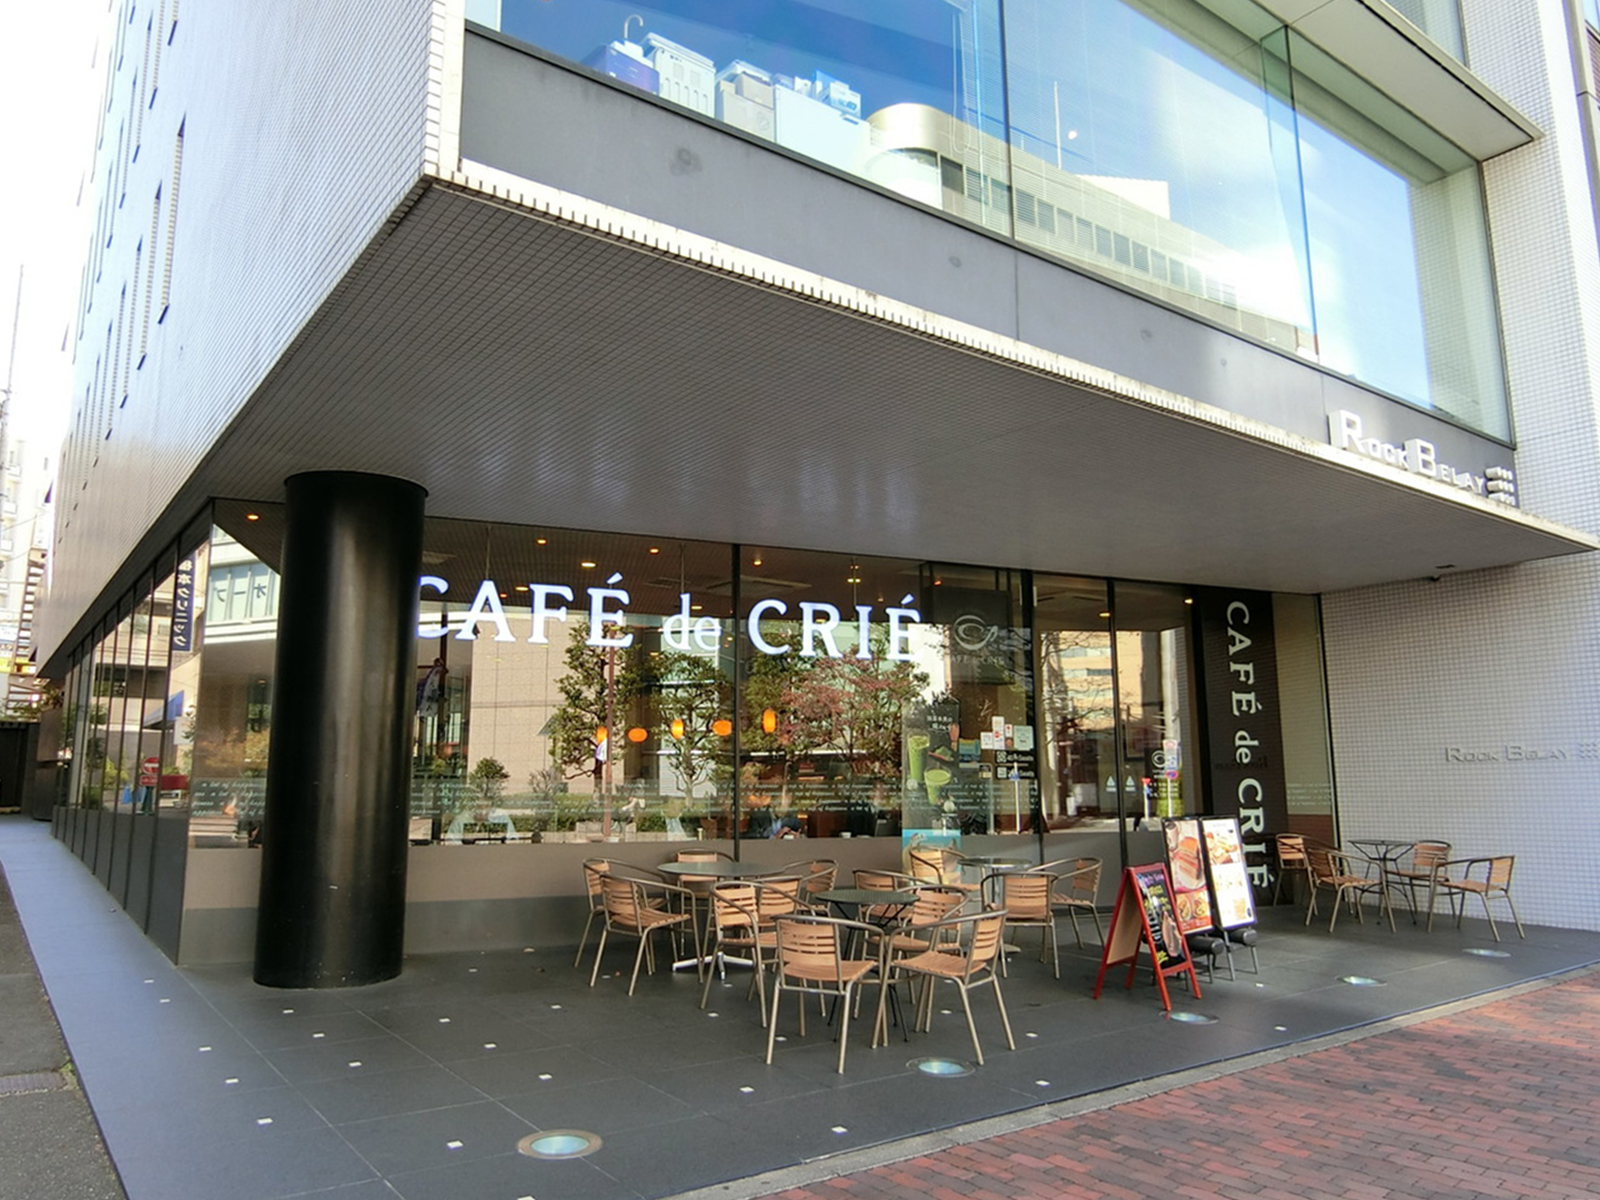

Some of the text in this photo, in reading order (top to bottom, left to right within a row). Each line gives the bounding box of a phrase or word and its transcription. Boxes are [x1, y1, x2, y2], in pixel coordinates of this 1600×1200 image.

[417, 572, 921, 660] CAFÉ de CRIÉ
[1226, 600, 1262, 717] CAFÉ
[1233, 729, 1260, 765] de
[1237, 777, 1275, 889] CRIÉ
